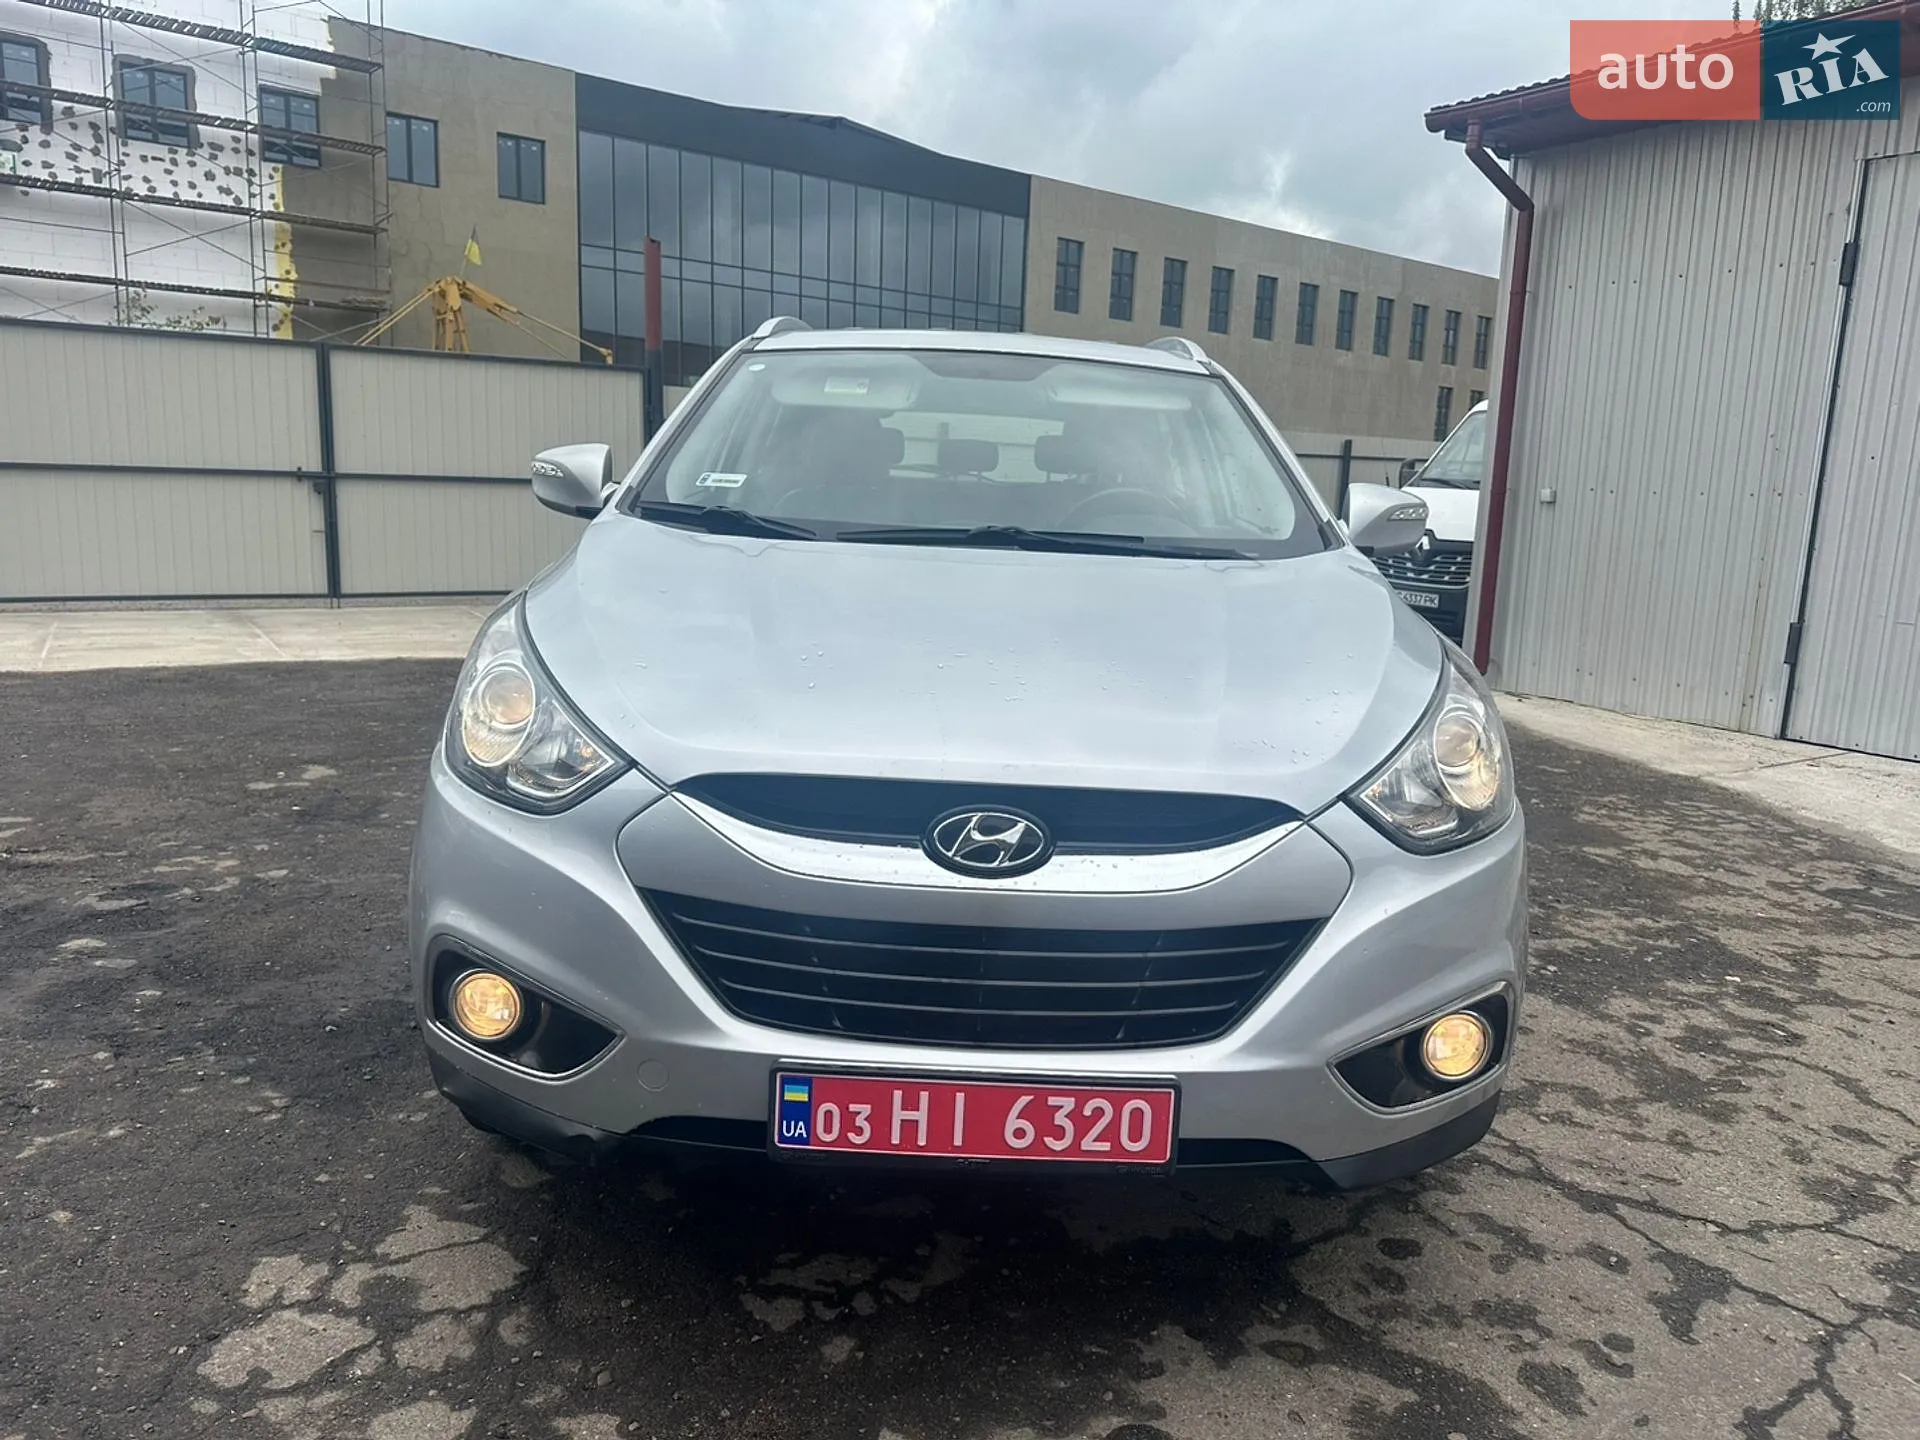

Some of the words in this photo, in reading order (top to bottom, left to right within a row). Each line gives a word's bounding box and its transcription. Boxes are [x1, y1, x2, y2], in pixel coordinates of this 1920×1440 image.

[782, 1119, 808, 1138] UA
[815, 1102, 873, 1145] 03
[890, 1089, 965, 1147] HI
[1003, 1095, 1153, 1152] 6320
